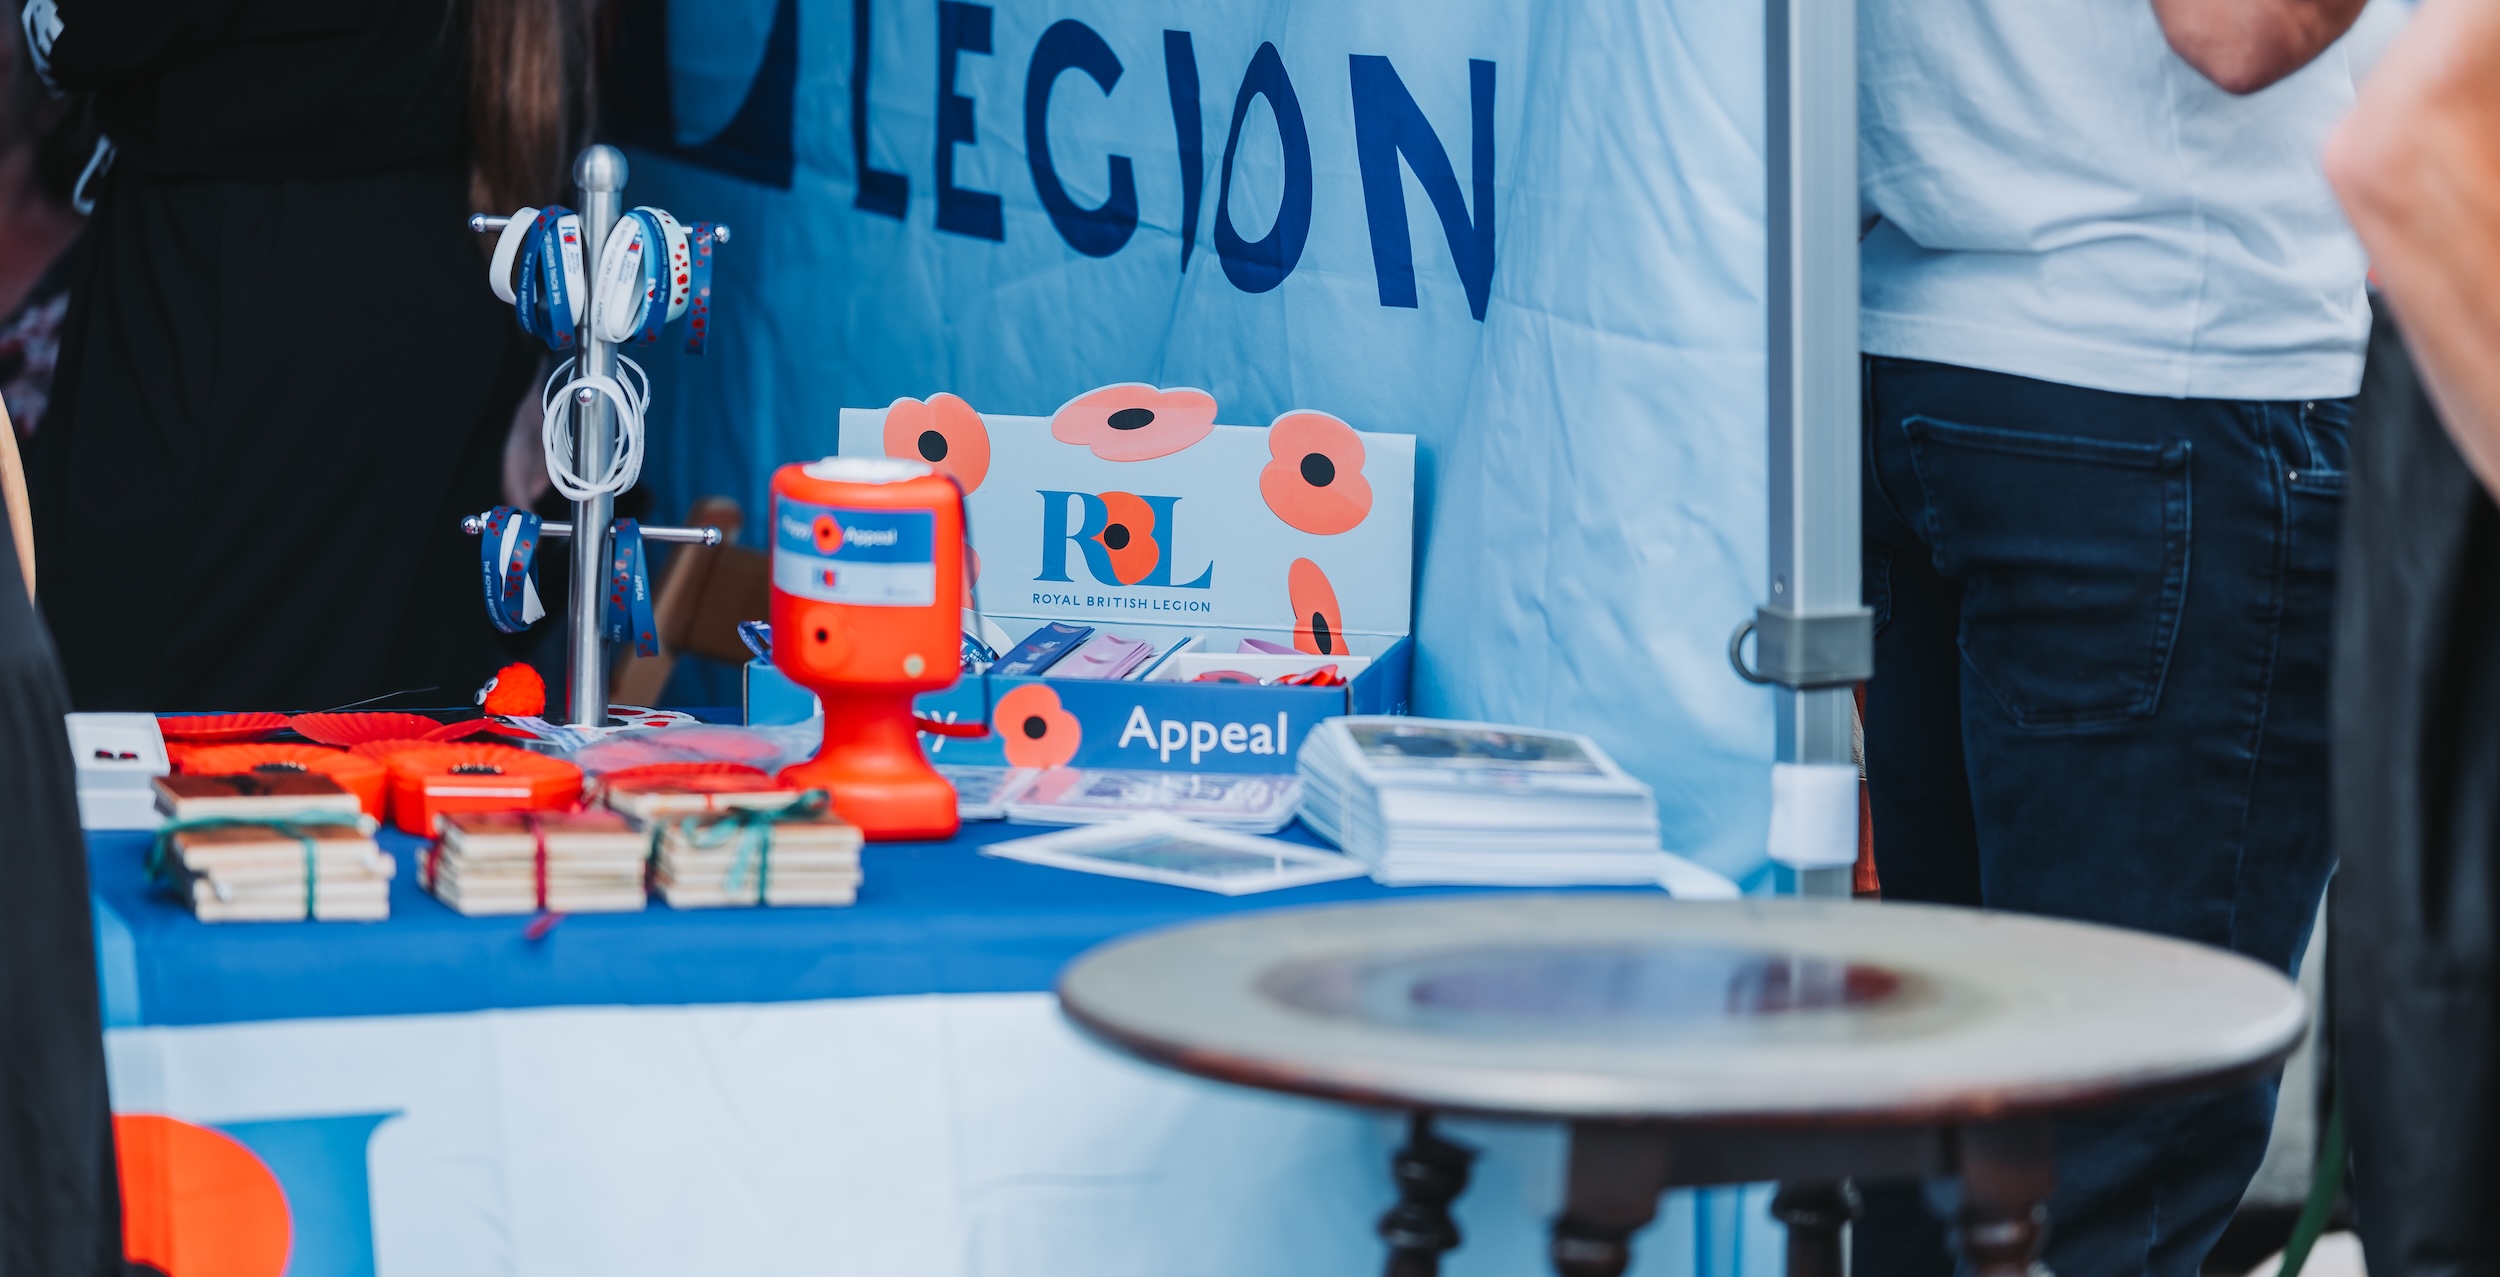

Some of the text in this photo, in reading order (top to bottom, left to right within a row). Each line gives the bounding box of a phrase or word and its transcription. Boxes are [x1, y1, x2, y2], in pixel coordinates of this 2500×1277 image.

[854, 0, 1496, 322] LEGION
[548, 268, 559, 292] ROYAL
[485, 575, 493, 597] ROYAL
[634, 574, 645, 601] APPEAL
[1032, 593, 1211, 613] ROYAL BRITISH LEGION
[1117, 704, 1288, 765] Appeal
